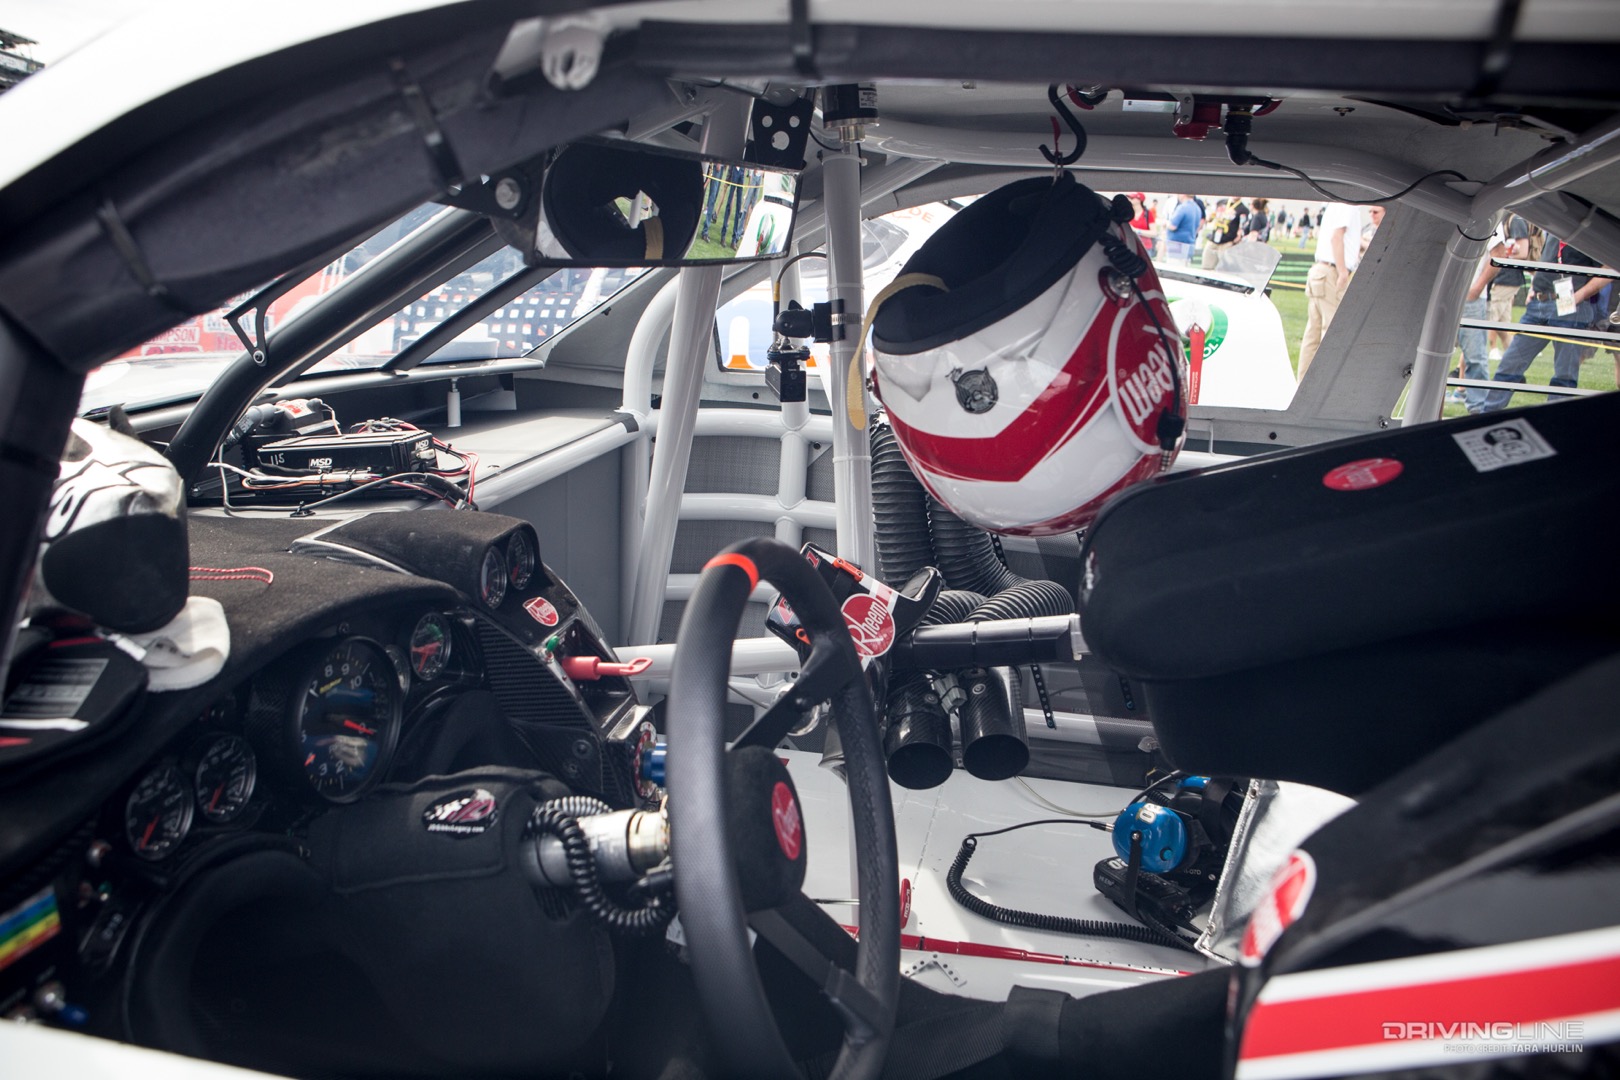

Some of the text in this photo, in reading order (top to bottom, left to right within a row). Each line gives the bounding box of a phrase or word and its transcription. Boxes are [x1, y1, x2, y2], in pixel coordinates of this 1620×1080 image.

[415, 440, 429, 450] MSD
[310, 458, 332, 468] MSD
[842, 601, 888, 655] Rheem
